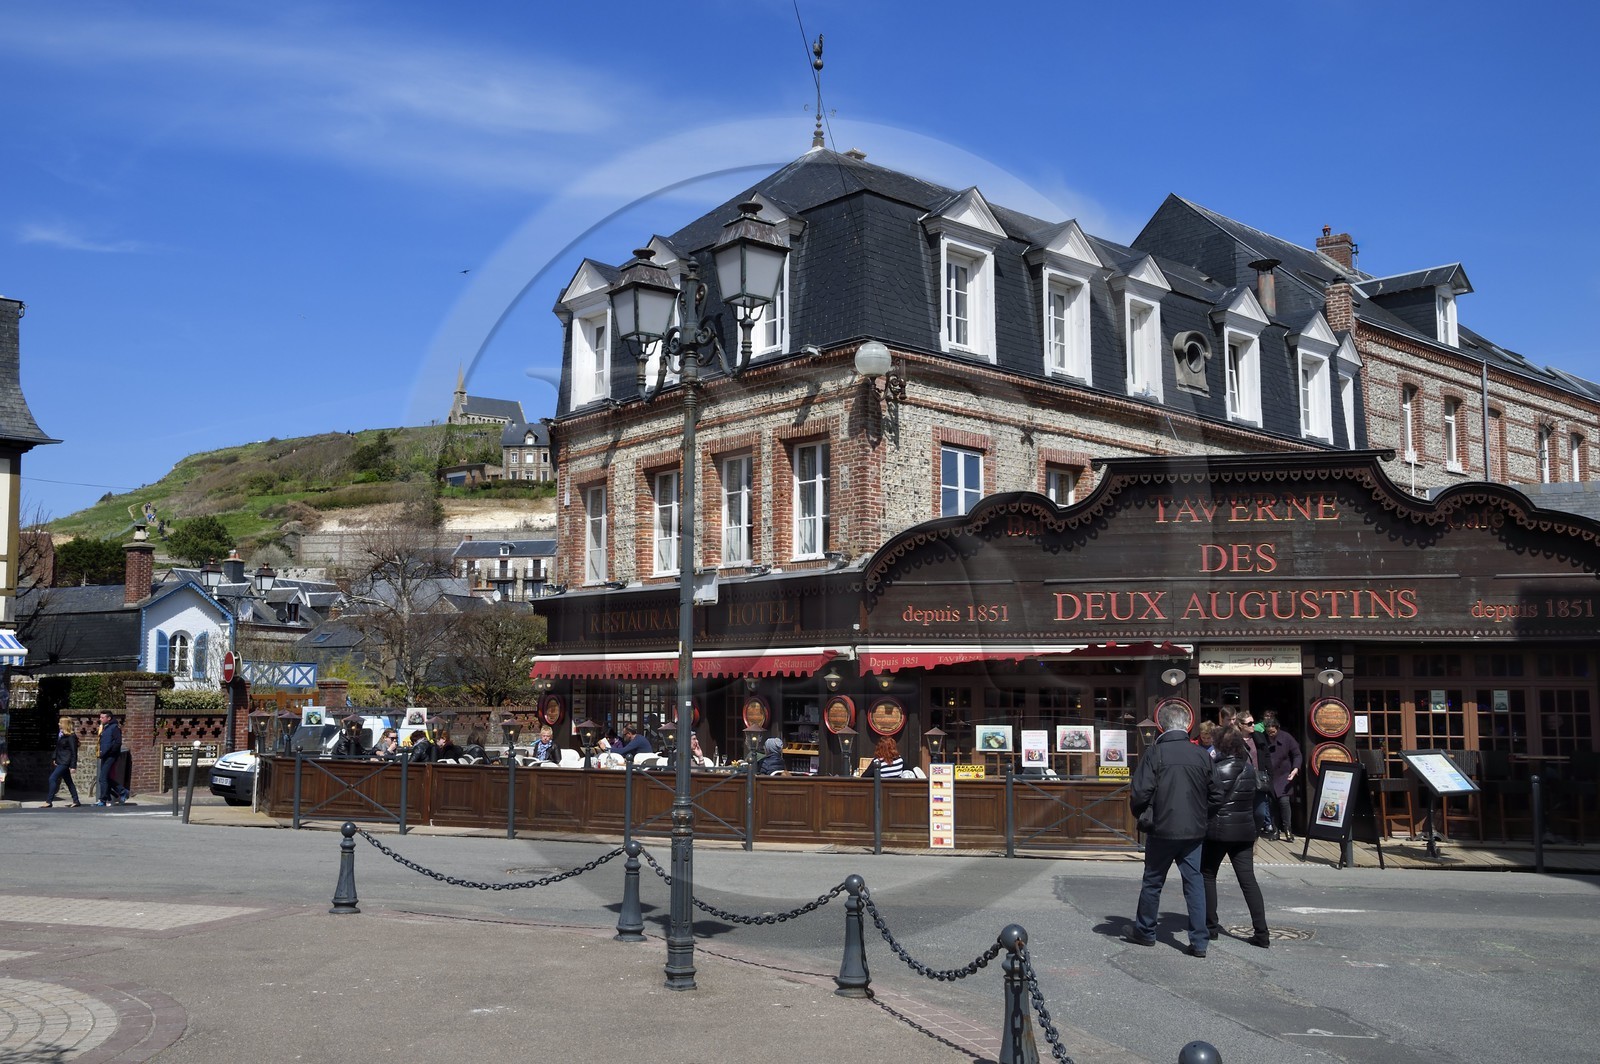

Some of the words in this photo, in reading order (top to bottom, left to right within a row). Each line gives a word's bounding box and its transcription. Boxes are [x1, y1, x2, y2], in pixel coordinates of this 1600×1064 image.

[1153, 492, 1342, 523] TAVERNE
[1449, 506, 1505, 529] Café
[1198, 542, 1278, 573] DES
[727, 601, 794, 627] HOTEL
[902, 604, 961, 626] depuis
[967, 604, 1009, 622] 1851
[1053, 591, 1168, 621] DEUX
[1181, 589, 1419, 620] AUGUSTINS
[1471, 599, 1538, 623] depuis
[1545, 599, 1595, 618] 1851
[637, 661, 650, 671] DES
[652, 660, 674, 671] DEUX
[773, 658, 816, 669] Restaurant
[869, 657, 899, 669] Depuis
[902, 656, 919, 665] 1851
